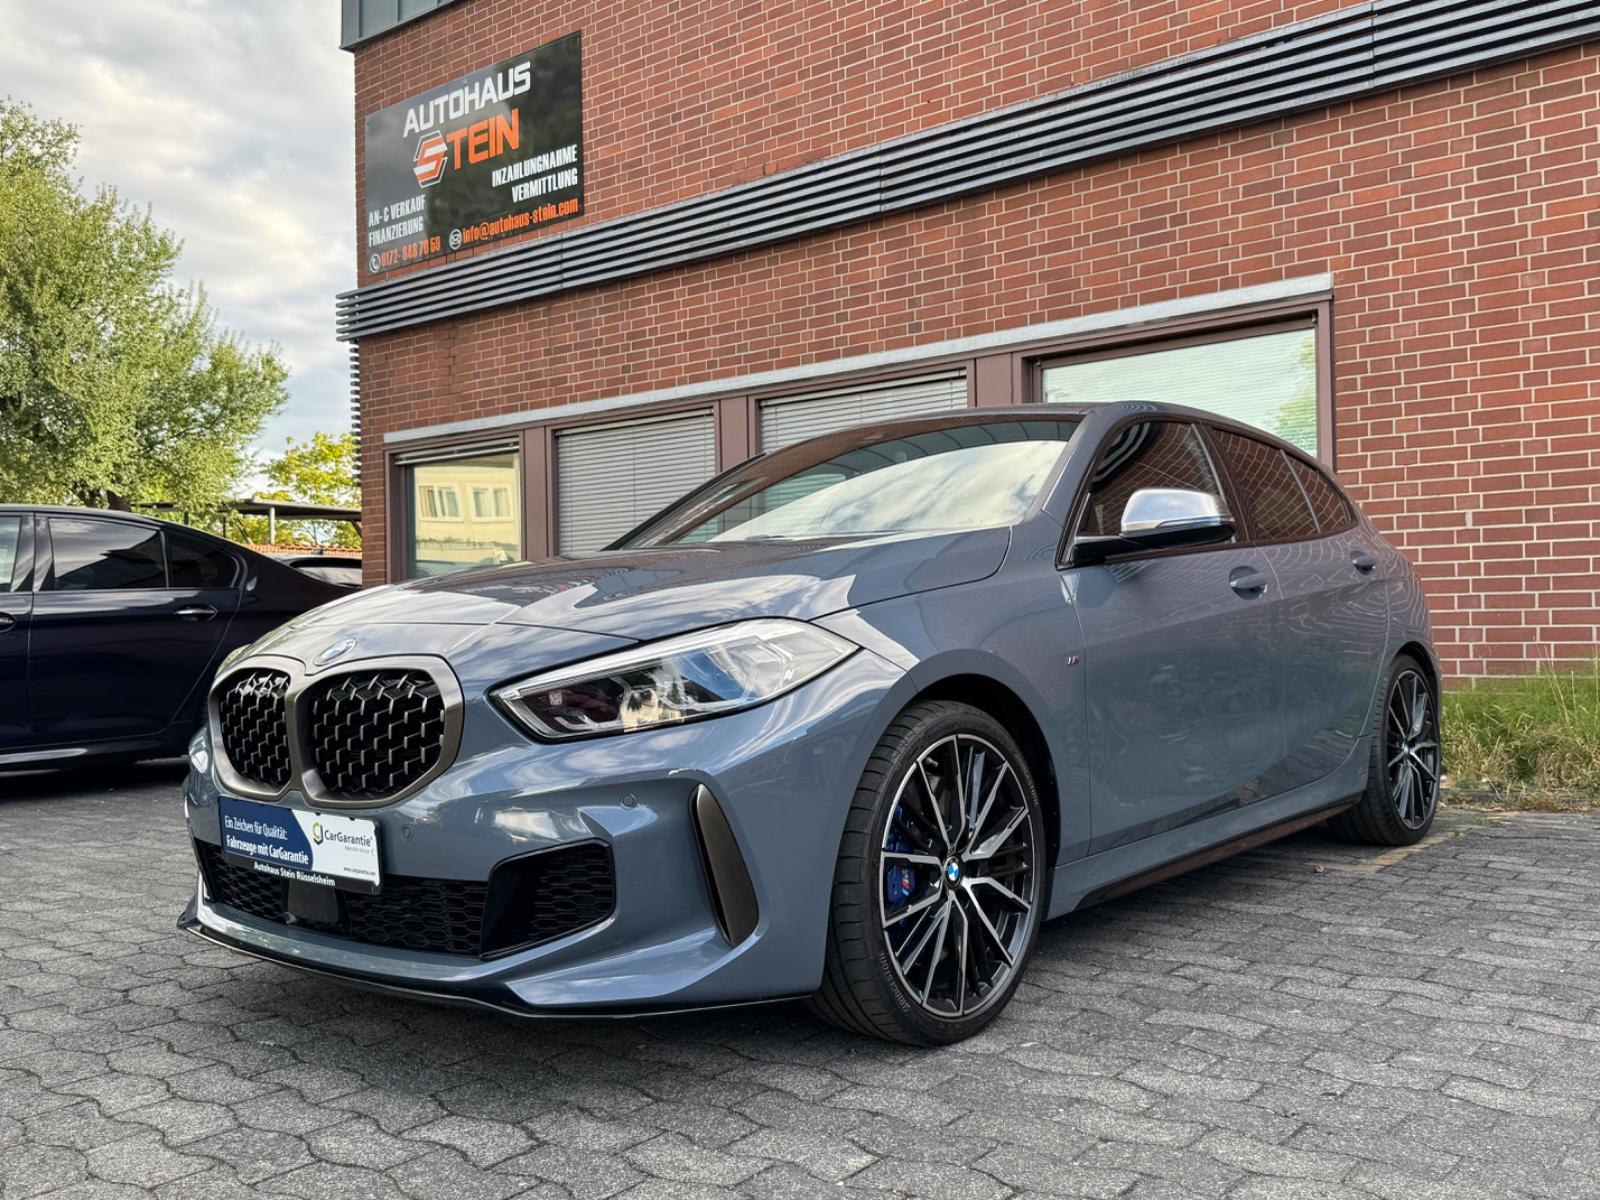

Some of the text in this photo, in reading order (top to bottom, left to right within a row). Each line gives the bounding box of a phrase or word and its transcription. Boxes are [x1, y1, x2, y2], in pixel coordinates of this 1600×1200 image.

[403, 61, 531, 138] AUTOHAUS
[491, 144, 578, 187] INZAHLUNGNAHME
[511, 167, 578, 203] VERMITTLUNG
[390, 194, 426, 220] VERKAUF
[462, 198, 579, 244] info@autohaus-stein.com
[368, 215, 424, 248] FINANZIERUNG
[224, 815, 234, 829] Ein
[233, 817, 254, 833] Zeichen
[226, 834, 309, 865] Fahrzeuge mit CarGarantie
[253, 861, 336, 887] Autohaus Stein Rüsselsheim
